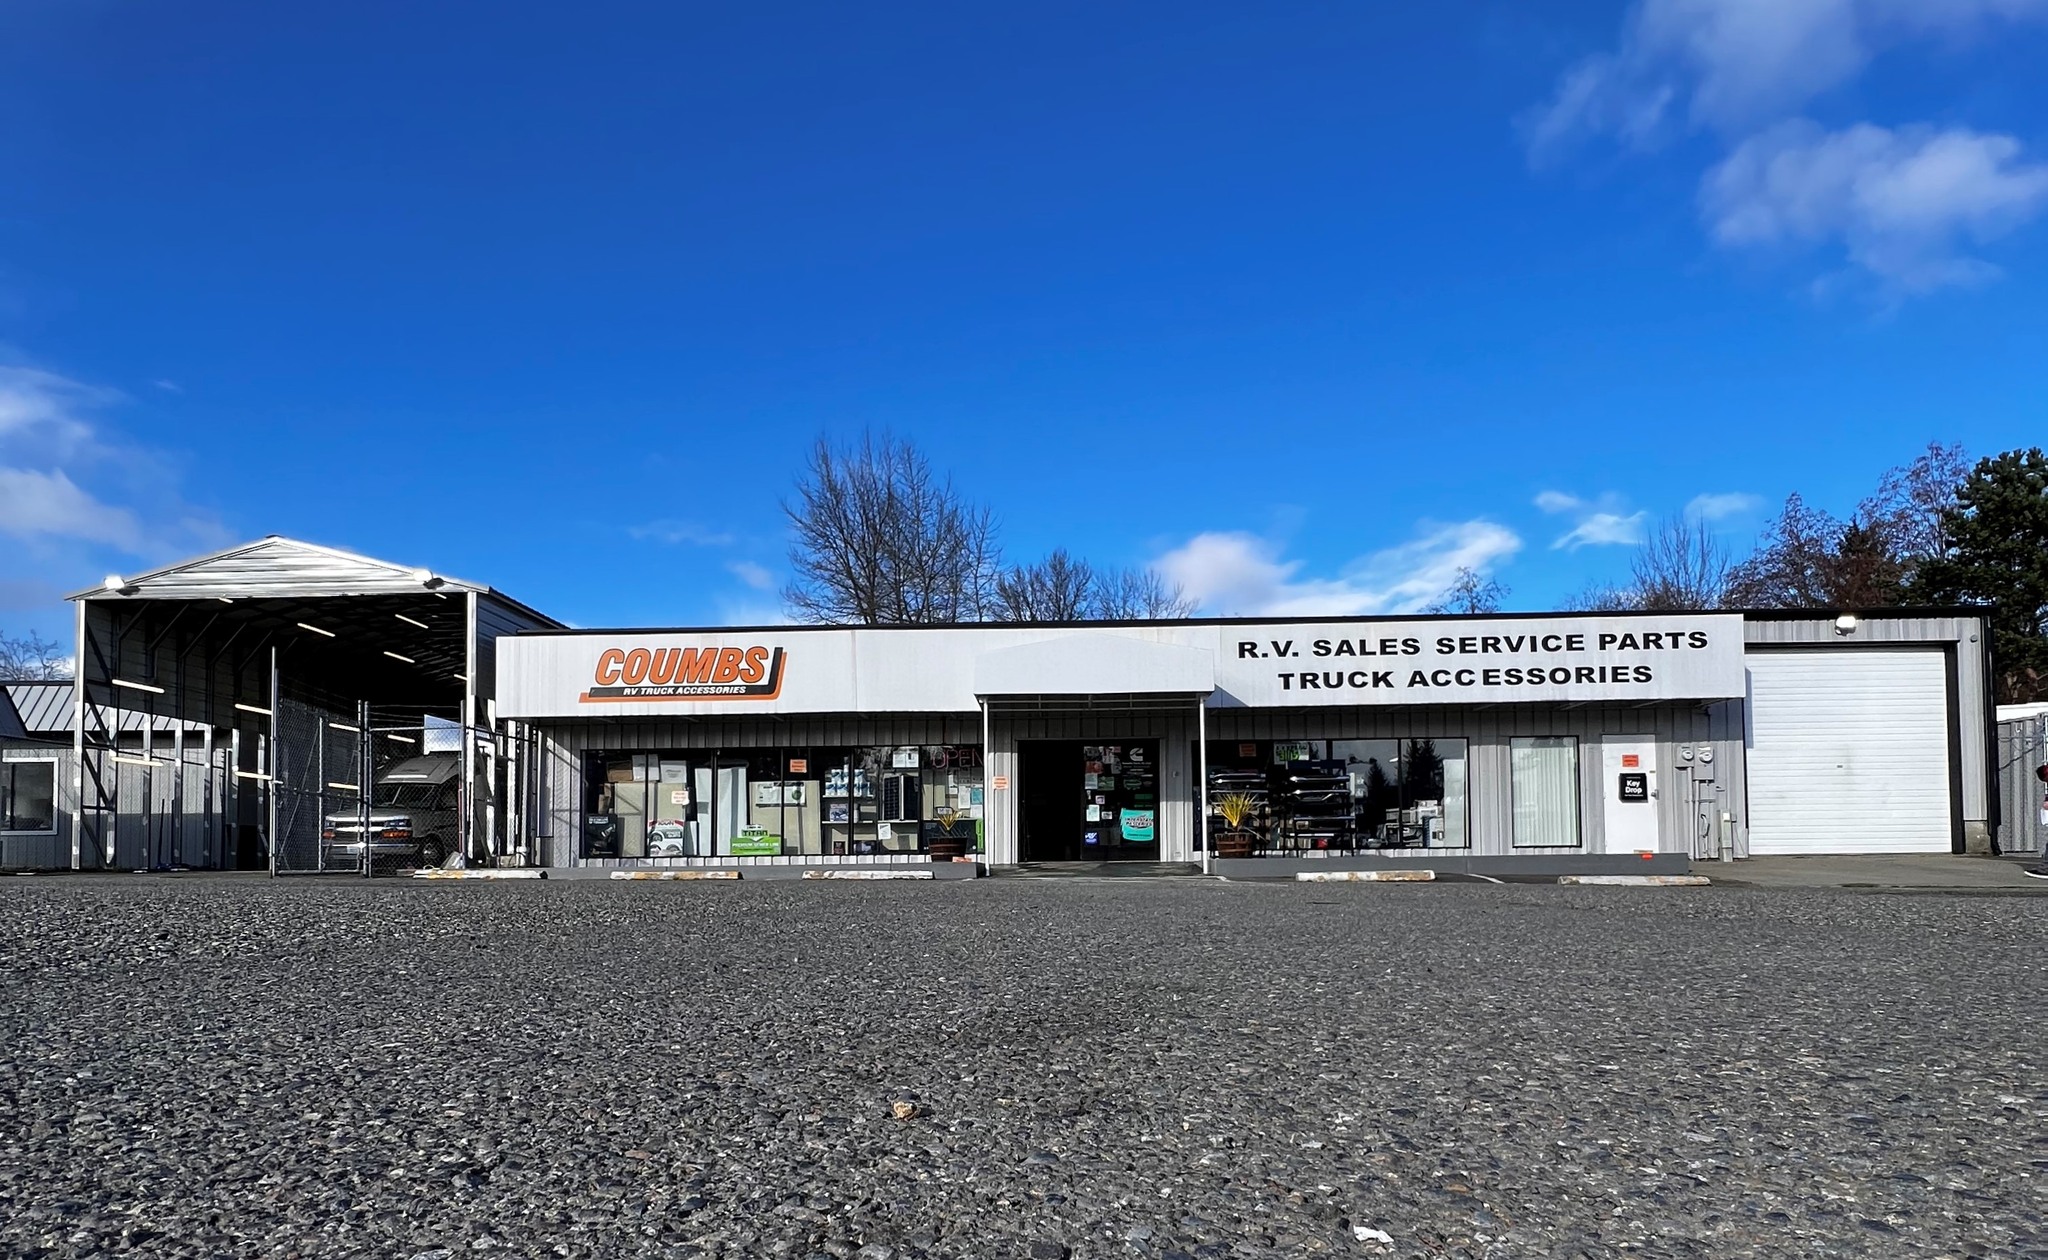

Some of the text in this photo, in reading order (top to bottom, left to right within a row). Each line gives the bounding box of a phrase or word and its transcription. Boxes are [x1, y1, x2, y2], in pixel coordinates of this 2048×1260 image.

[1238, 631, 1709, 659] R.V. SALES SERVICE PARTS
[595, 646, 769, 686] COUMBS
[1278, 665, 1653, 690] TRUCK ACCESSORIES
[623, 686, 746, 696] RV TRUCK ACCESSORIES
[932, 747, 984, 769] OPEN
[1625, 786, 1642, 794] Drop
[1626, 780, 1640, 788] Key
